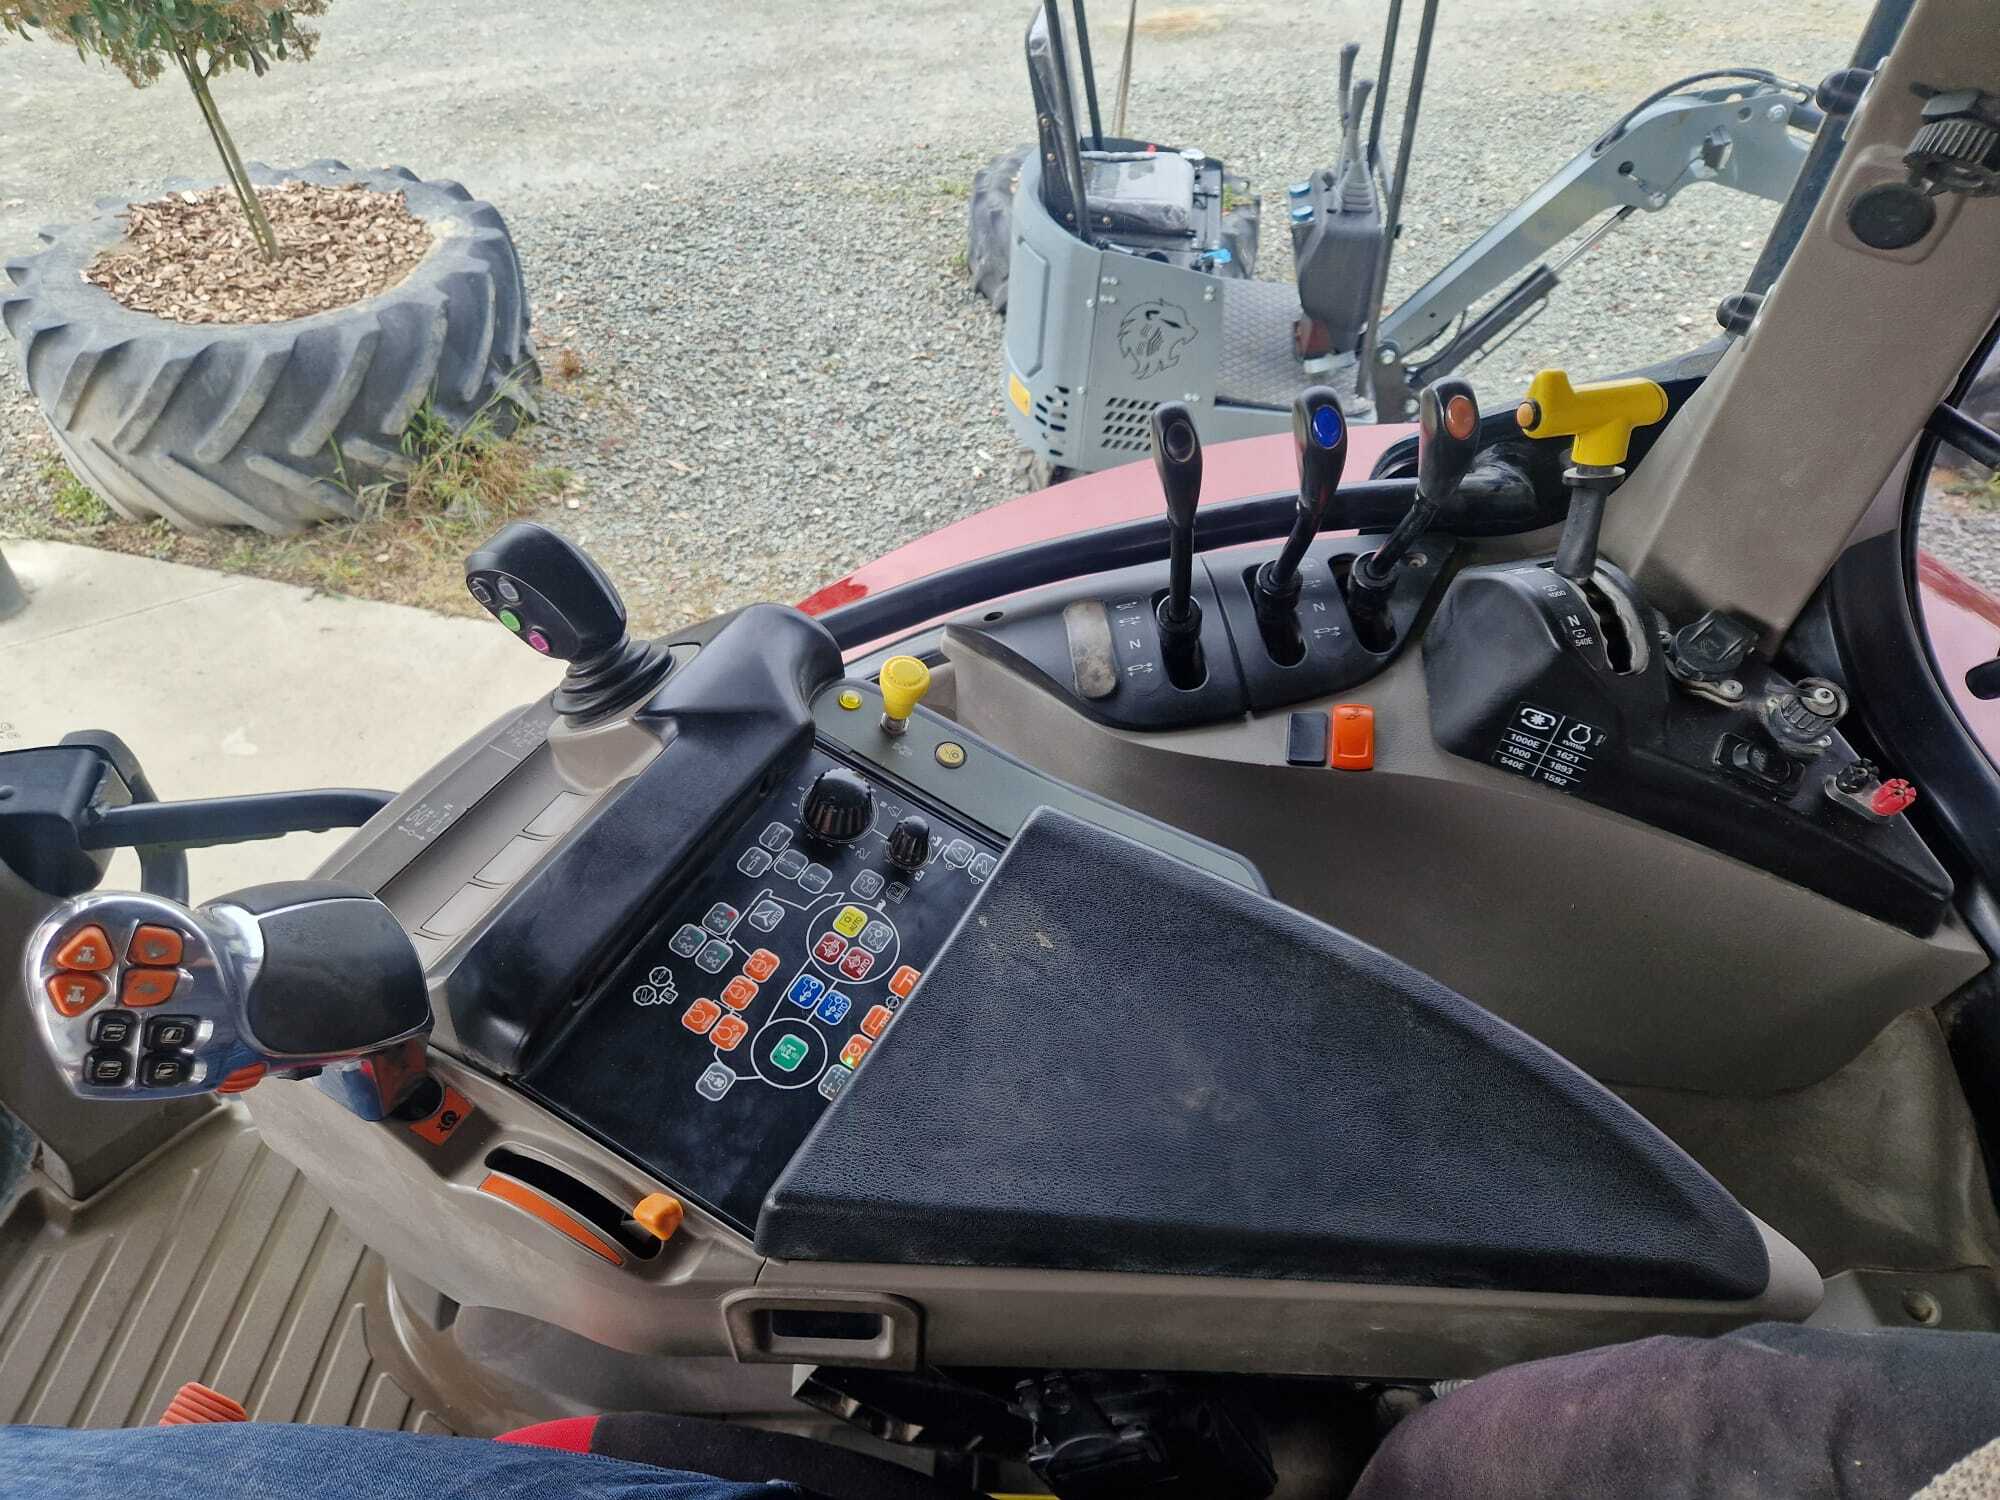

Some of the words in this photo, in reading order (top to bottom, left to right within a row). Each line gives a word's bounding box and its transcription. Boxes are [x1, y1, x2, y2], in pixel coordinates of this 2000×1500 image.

[1312, 601, 1326, 612] N
[1567, 614, 1581, 627] N
[1129, 638, 1141, 649] N
[1510, 733, 1541, 750] 1000E
[1508, 746, 1531, 760] 1000
[1555, 749, 1580, 764] 1621
[1500, 756, 1526, 771] 540E
[1550, 761, 1574, 776] 1893
[1543, 772, 1567, 787] 1592
[768, 910, 781, 926] AUTO
[856, 958, 871, 976] AUTO
[833, 1002, 848, 1020] AUTO
